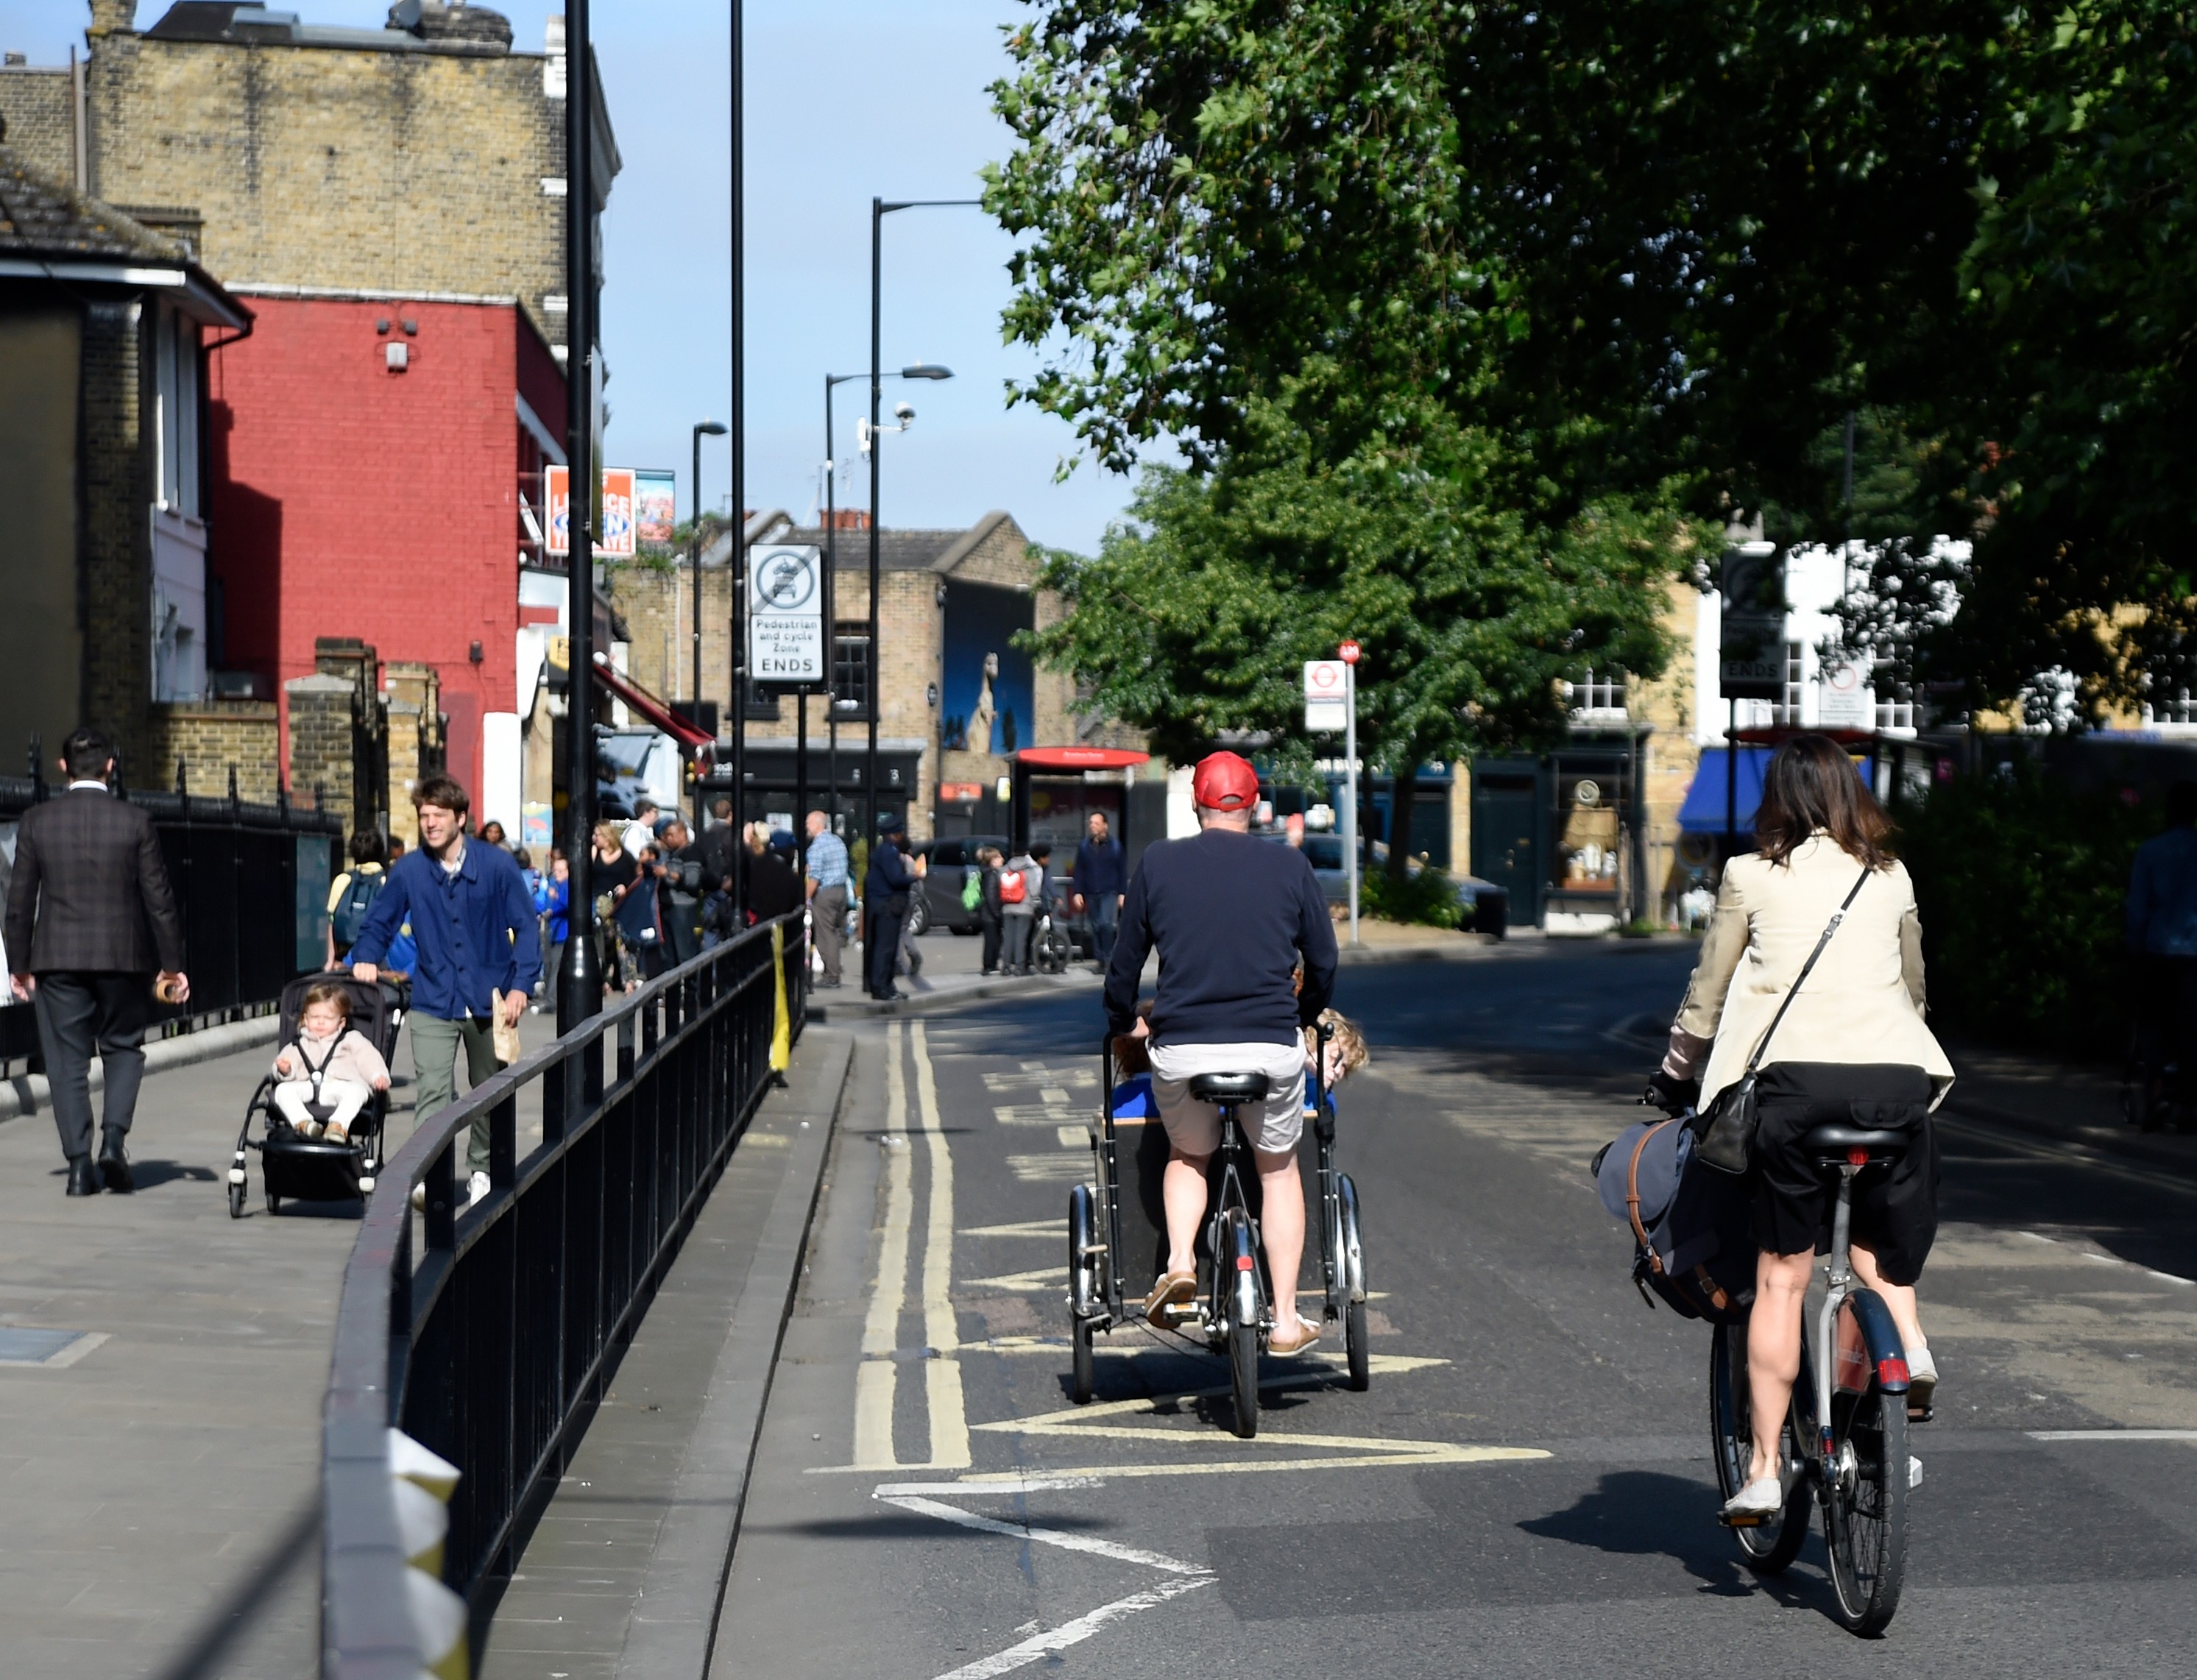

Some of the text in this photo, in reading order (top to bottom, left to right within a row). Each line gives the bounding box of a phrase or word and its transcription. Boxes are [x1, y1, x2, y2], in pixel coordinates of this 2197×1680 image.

[552, 491, 630, 513] LICE
[757, 619, 817, 629] Pedestrian
[760, 631, 813, 642] and cycle
[773, 642, 801, 652] Zone
[762, 658, 813, 672] ENDS
[1728, 662, 1778, 678] ENDS
